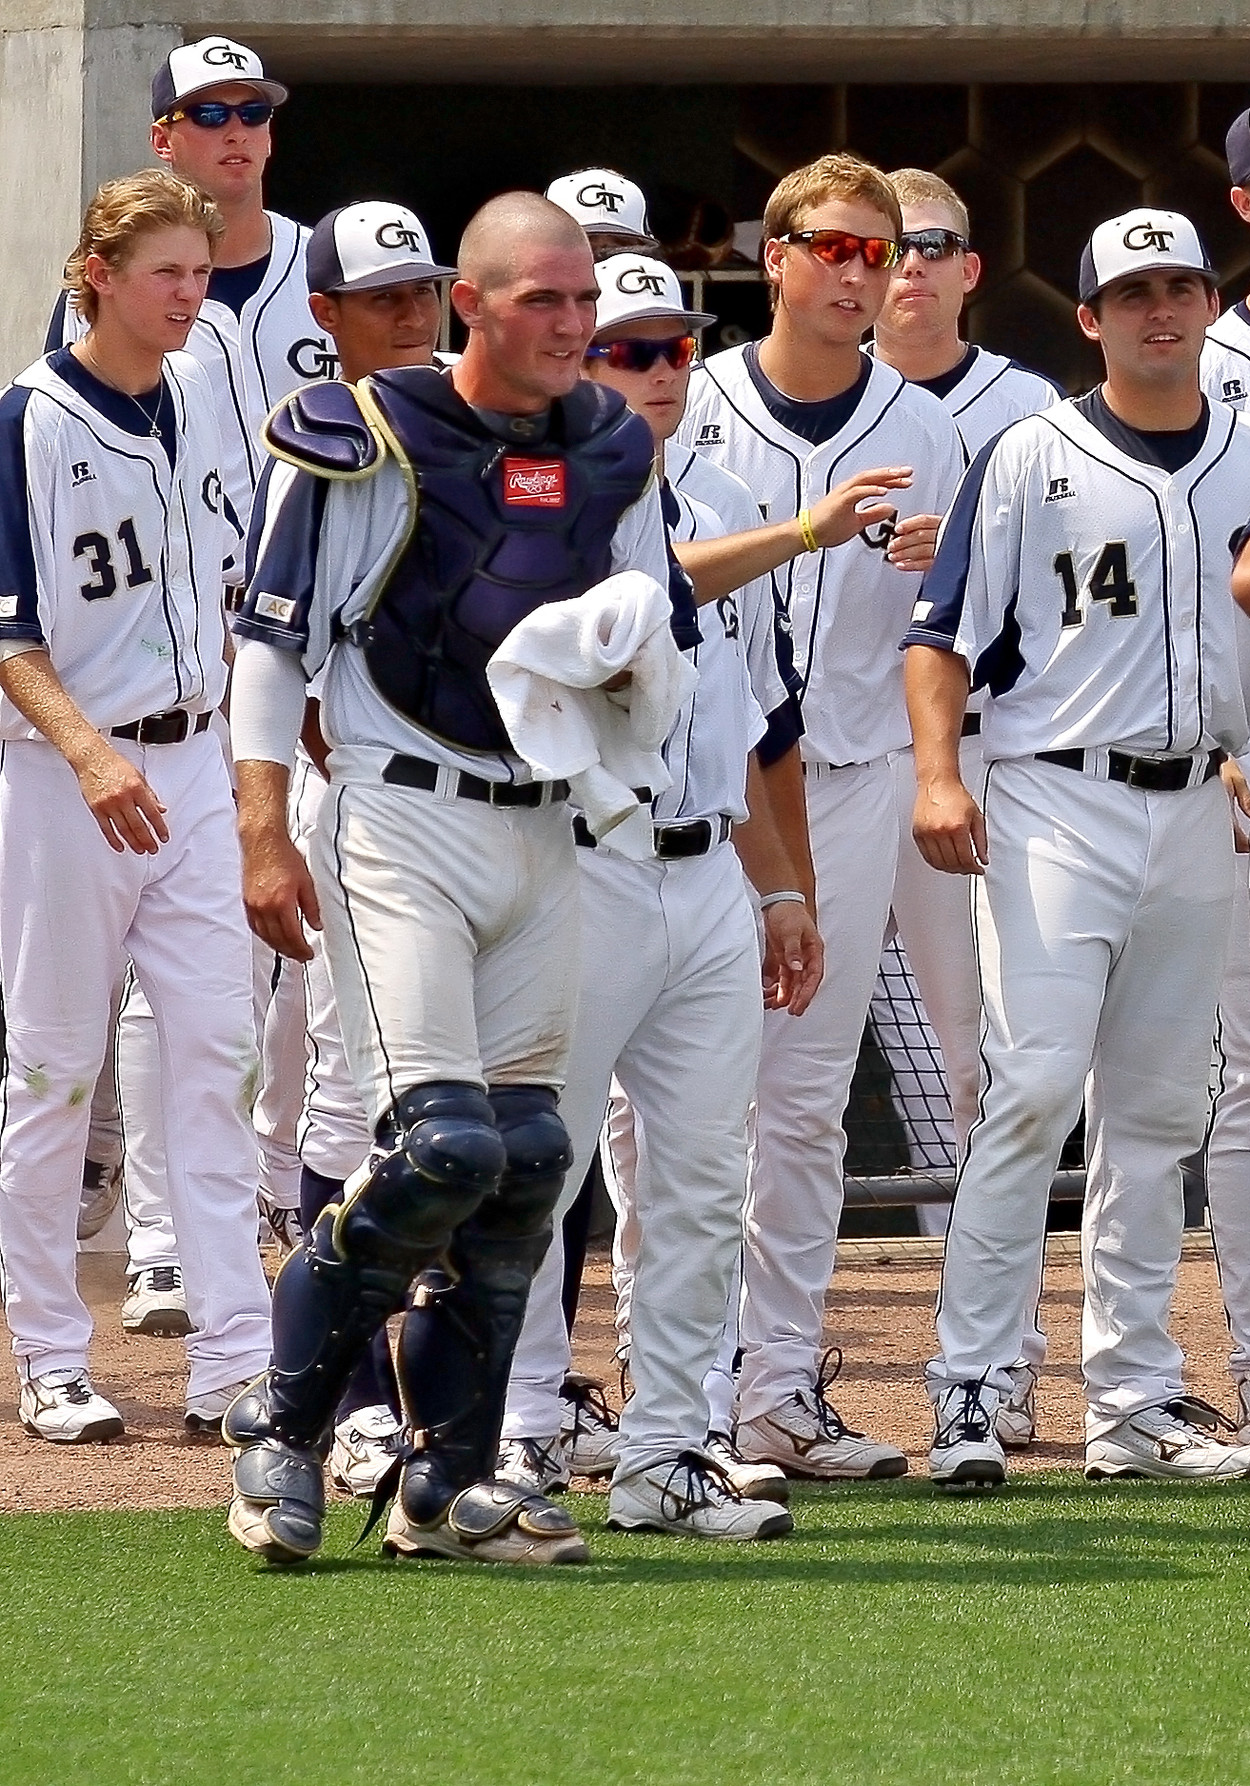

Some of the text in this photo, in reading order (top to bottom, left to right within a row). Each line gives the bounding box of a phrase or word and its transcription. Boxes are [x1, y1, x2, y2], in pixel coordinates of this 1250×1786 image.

[203, 45, 248, 71] GT
[577, 183, 625, 213] GT
[375, 219, 421, 253] GT
[1123, 221, 1175, 252] GT
[617, 266, 667, 296] GT
[509, 471, 559, 491] Rawlings
[72, 516, 156, 602] 31
[1052, 538, 1139, 629] 14
